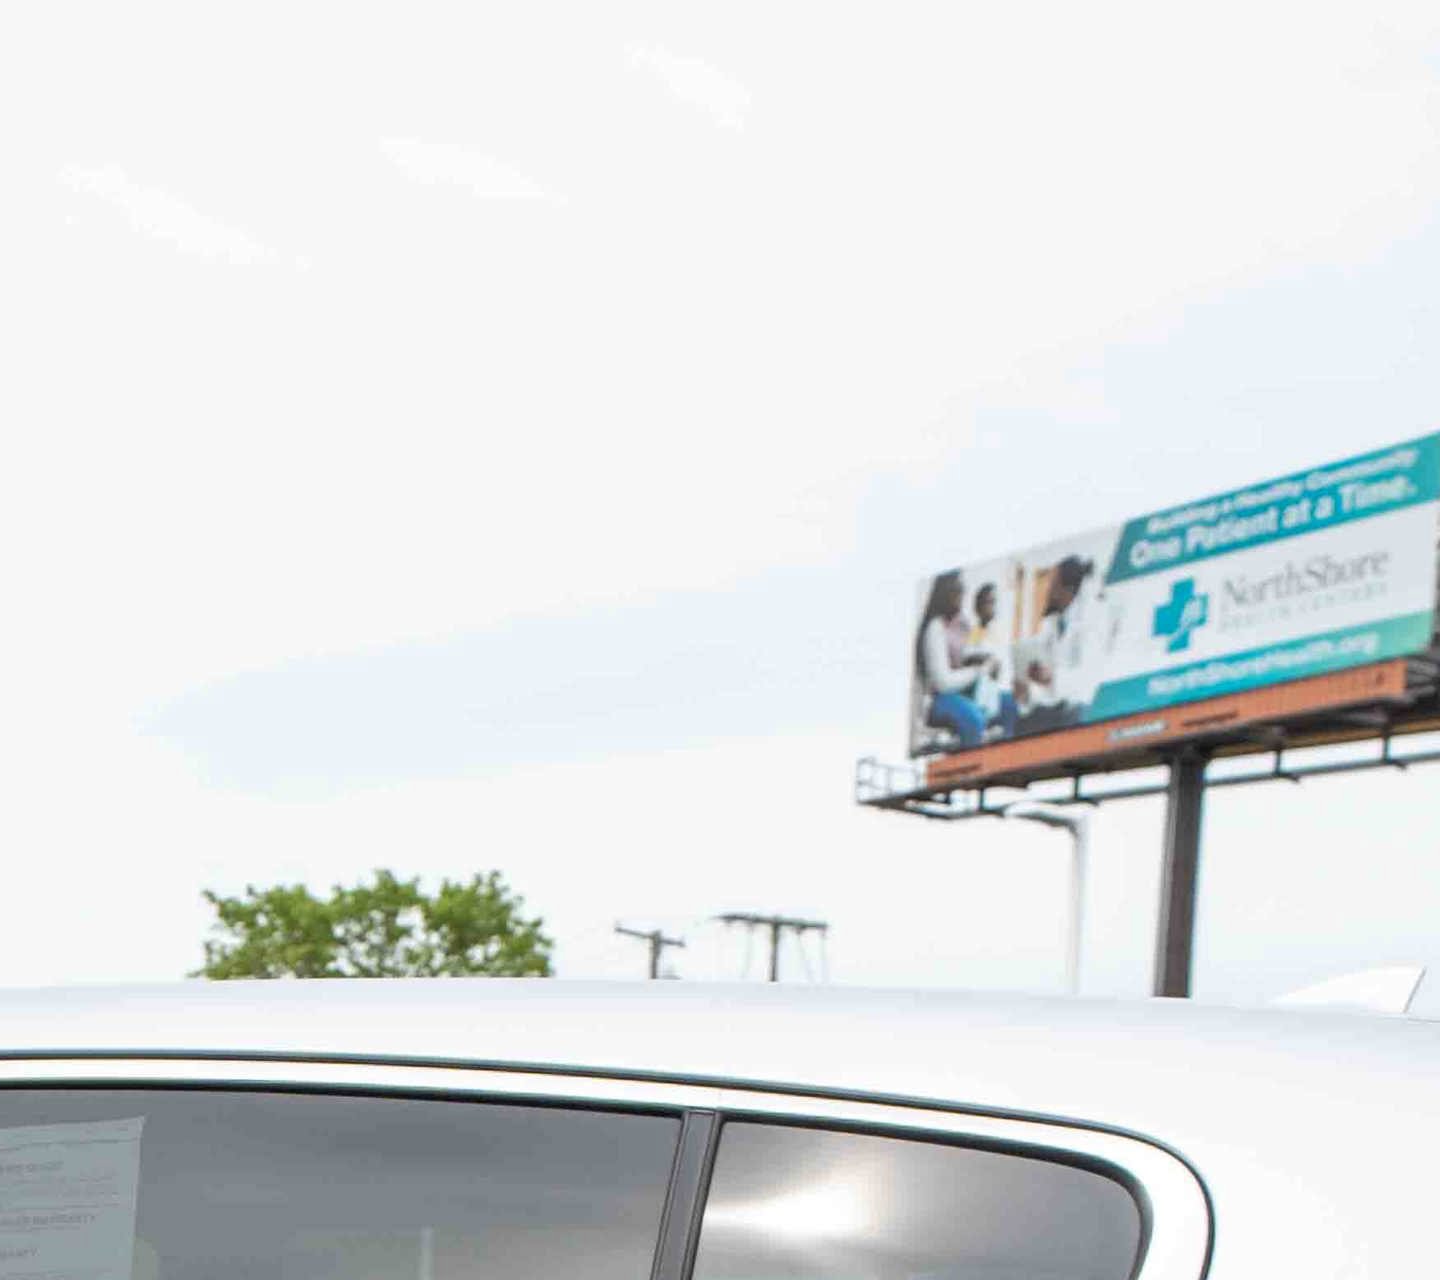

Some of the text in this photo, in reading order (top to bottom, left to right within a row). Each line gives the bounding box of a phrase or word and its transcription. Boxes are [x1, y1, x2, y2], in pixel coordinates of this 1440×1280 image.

[1129, 535, 1182, 568] One
[1186, 504, 1279, 550] Patient
[1223, 549, 1389, 606] NorthShore
